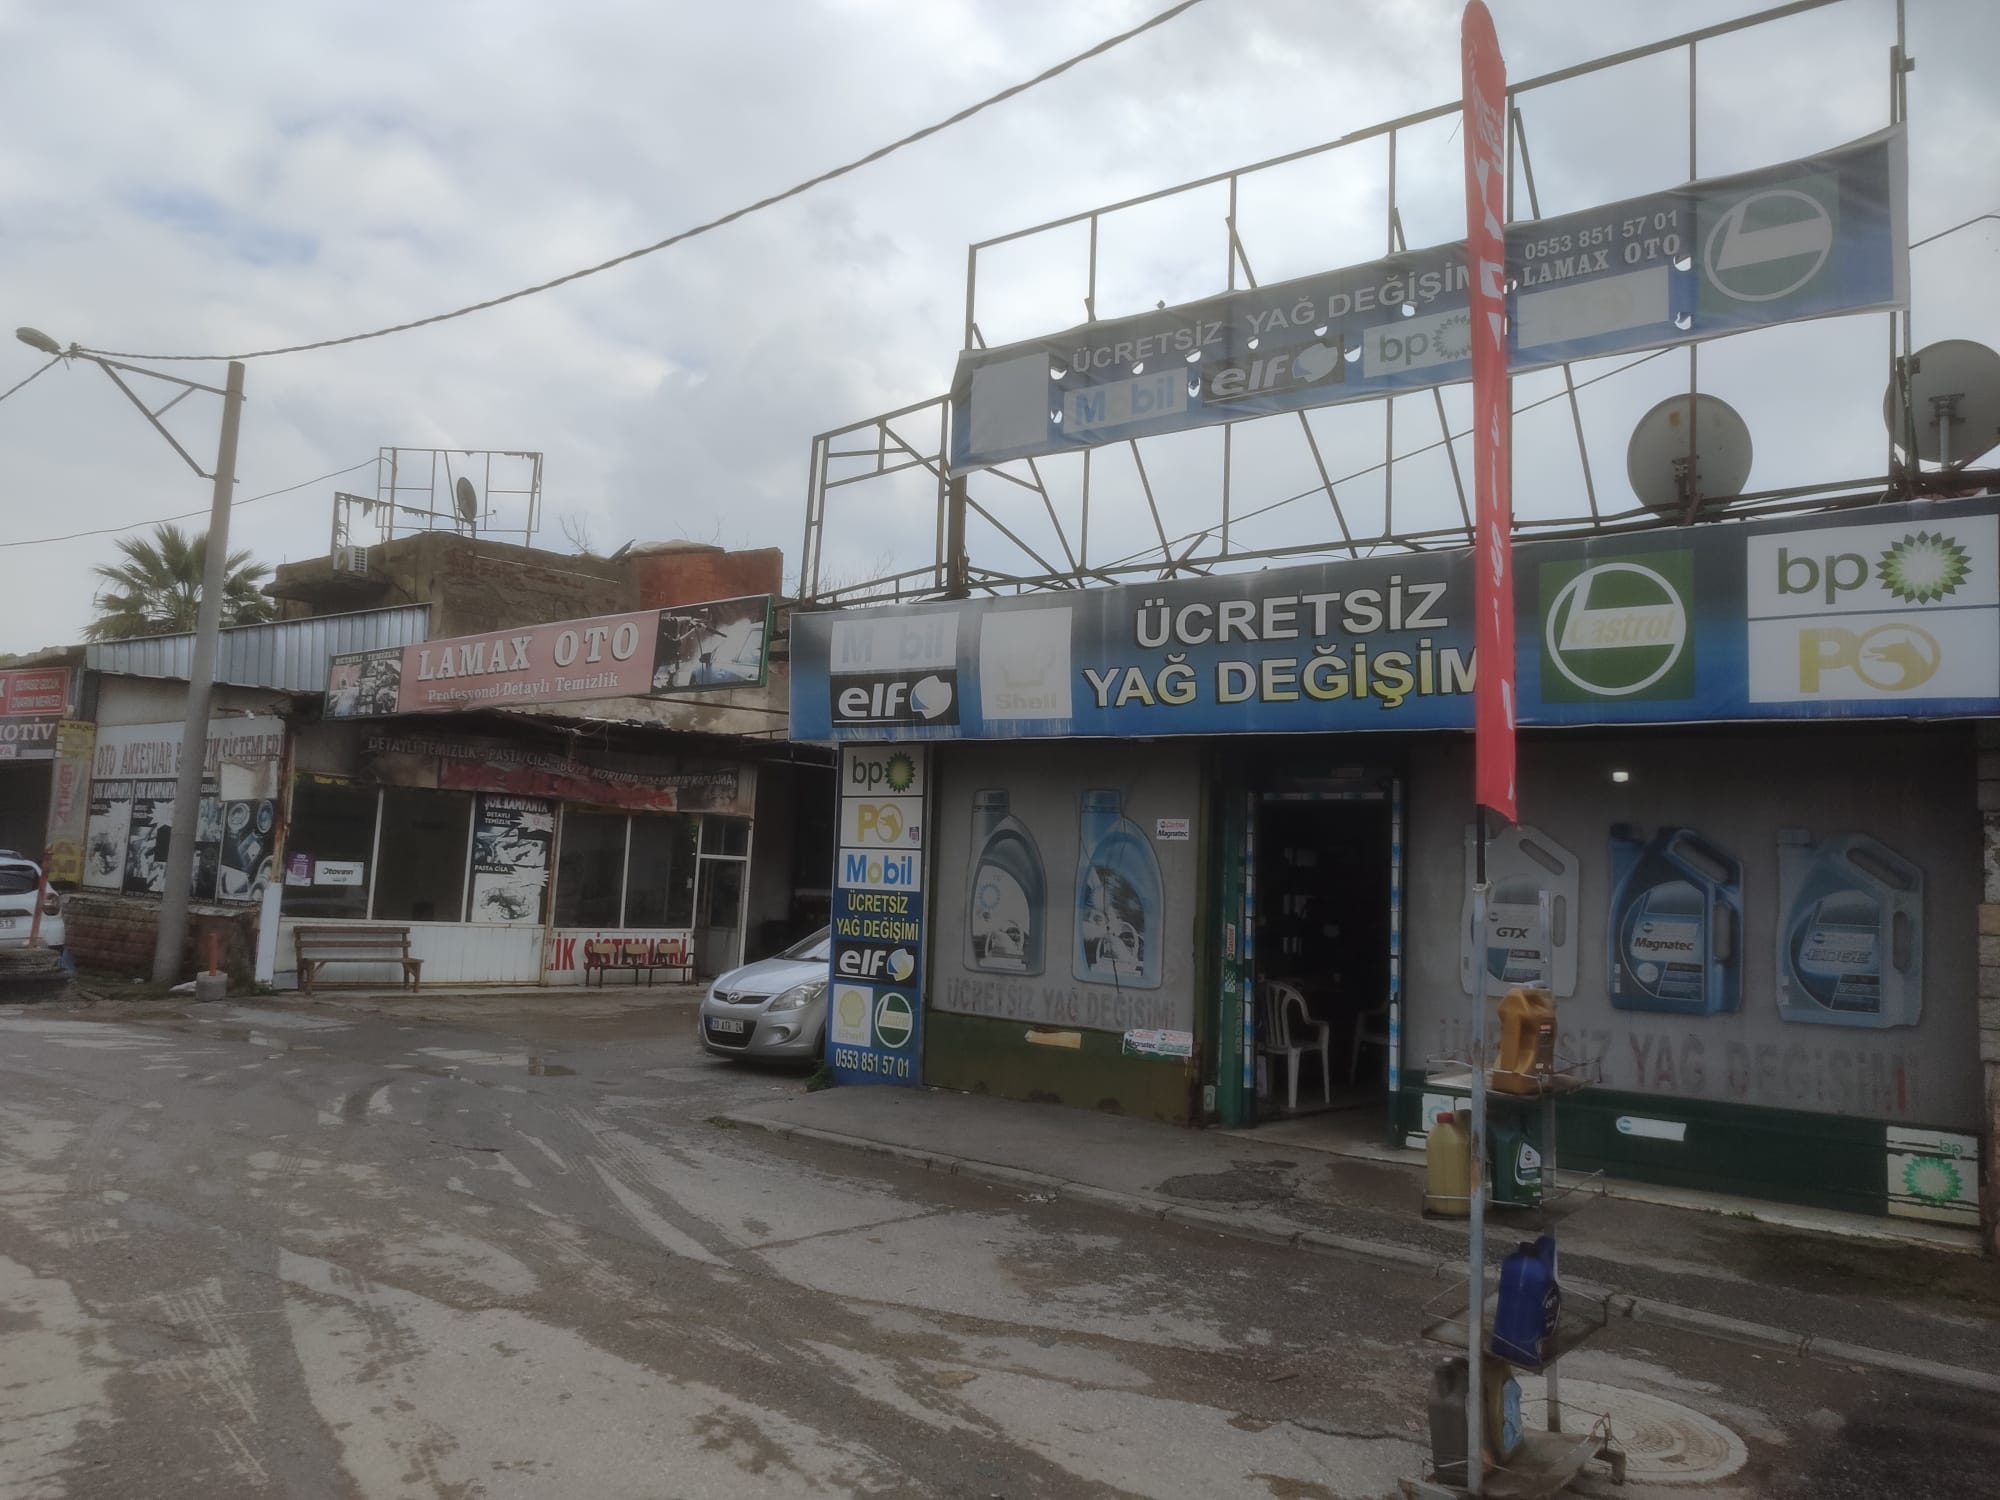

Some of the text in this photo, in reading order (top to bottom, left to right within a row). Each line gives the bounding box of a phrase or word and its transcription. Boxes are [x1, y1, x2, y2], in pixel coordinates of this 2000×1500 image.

[1524, 209, 1679, 260] 0553 851 57 01
[1521, 233, 1681, 287] LAMAX OTO
[1072, 319, 1223, 372] ÜCRETSİZ
[1245, 295, 1316, 336] YAĞ
[1378, 332, 1430, 366] bp
[1210, 353, 1290, 396] elf
[1776, 546, 1869, 606] bp
[1134, 574, 1450, 650] ÜCRETSİZ
[416, 621, 640, 682] LAMAX OTO
[428, 682, 500, 704] Profesyonel
[555, 670, 620, 691] Temizlik
[1082, 653, 1199, 709] YAĞ
[838, 681, 909, 718] elf
[97, 744, 117, 775] OTO
[851, 756, 883, 792] bp
[845, 854, 913, 887] Mobil
[847, 890, 908, 915] ÜCRETSİZ
[836, 915, 920, 944] YAĞ DEĞİŞİMİ
[1495, 926, 1531, 939] GTX
[1633, 936, 1695, 952] Magnatec
[839, 948, 887, 977] elf
[835, 1048, 910, 1079] 0553 851 57 01
